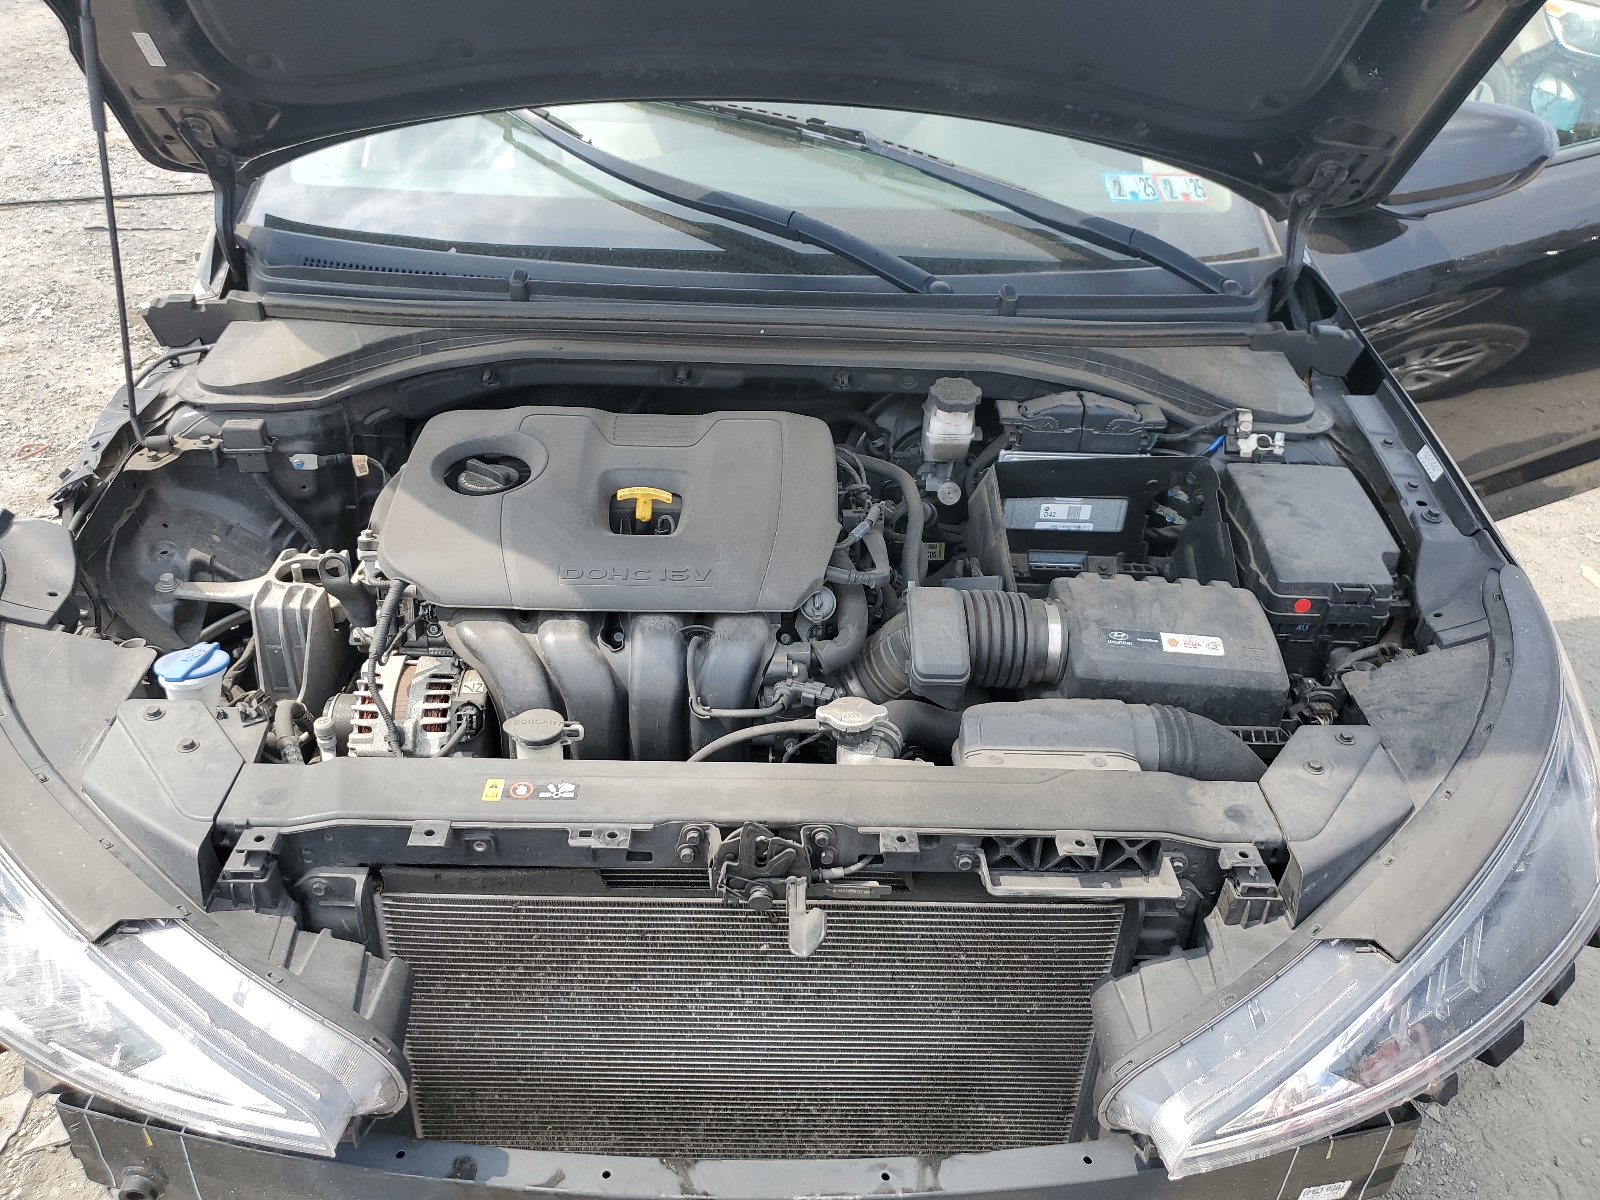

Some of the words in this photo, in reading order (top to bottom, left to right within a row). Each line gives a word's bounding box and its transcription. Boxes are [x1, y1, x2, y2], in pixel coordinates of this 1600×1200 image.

[1113, 179, 1126, 198] 2
[1163, 179, 1178, 200] 2
[561, 567, 651, 581] DOHC
[513, 719, 564, 727] COOLANT
